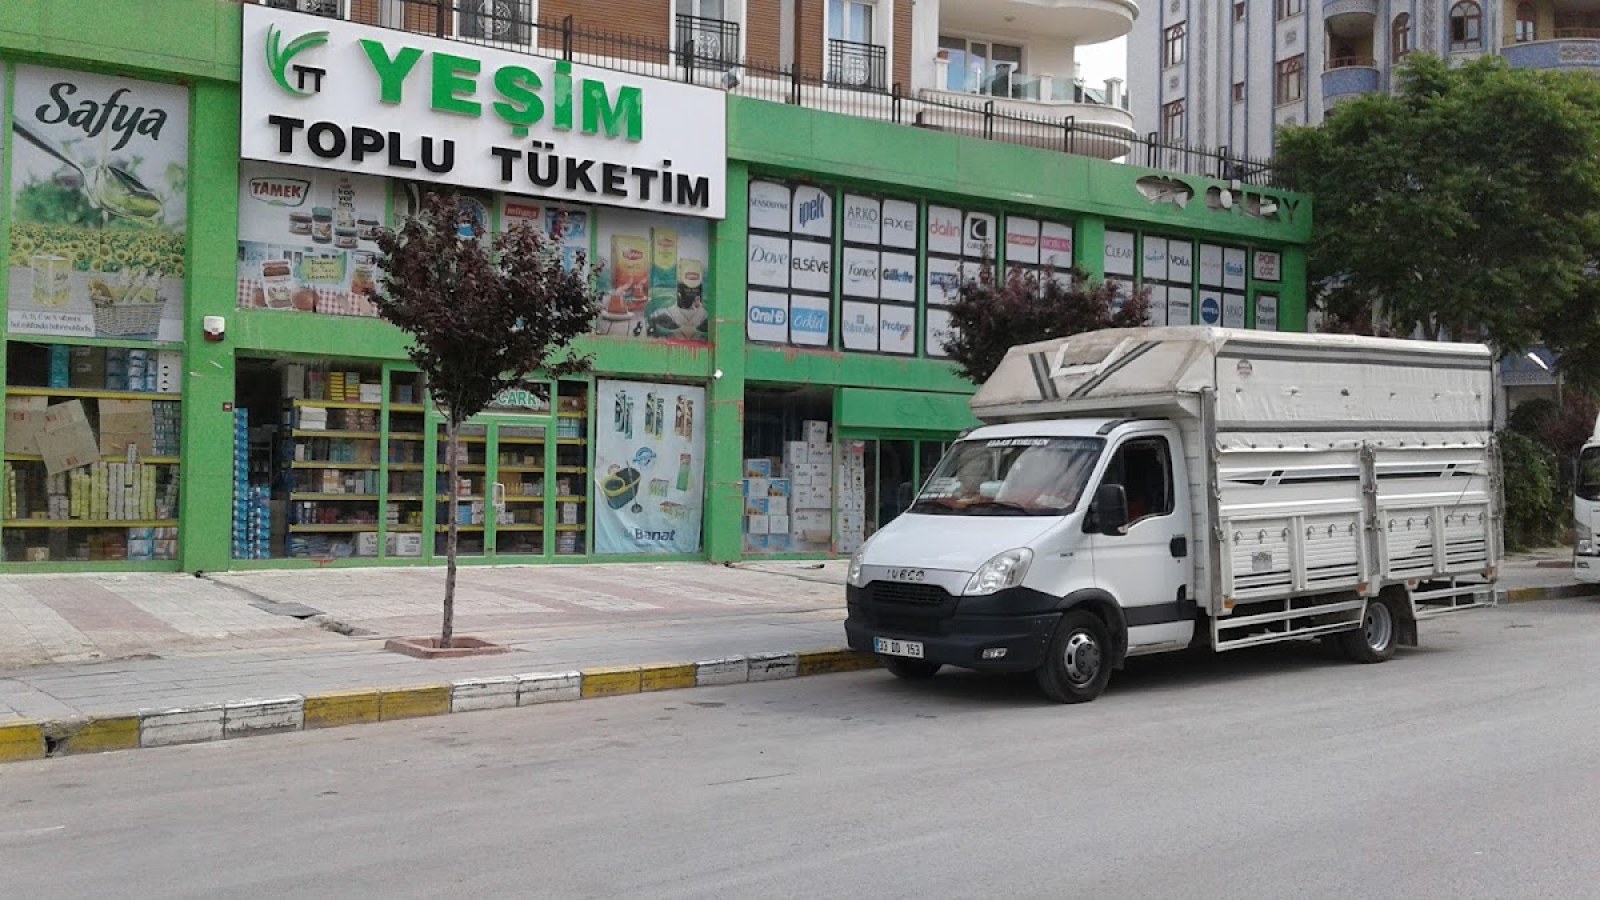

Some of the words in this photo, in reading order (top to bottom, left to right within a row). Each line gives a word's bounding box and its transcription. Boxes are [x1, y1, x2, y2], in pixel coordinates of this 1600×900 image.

[292, 64, 326, 93] TT
[358, 38, 643, 142] YEŞİM
[35, 82, 168, 151] Safya
[268, 114, 455, 174] TOPLU
[491, 140, 710, 208] TÜKETİM
[251, 182, 301, 198] TAMEK
[799, 193, 825, 228] ipek
[848, 205, 878, 222] ARKO
[884, 217, 913, 231] AXE
[930, 218, 960, 237] dalin
[751, 247, 788, 266] Dove
[1105, 245, 1133, 259] CLEAR
[752, 308, 785, 323] Oral-B
[635, 527, 676, 541] Banat
[886, 569, 925, 581] IVECO
[906, 643, 921, 656] 153
